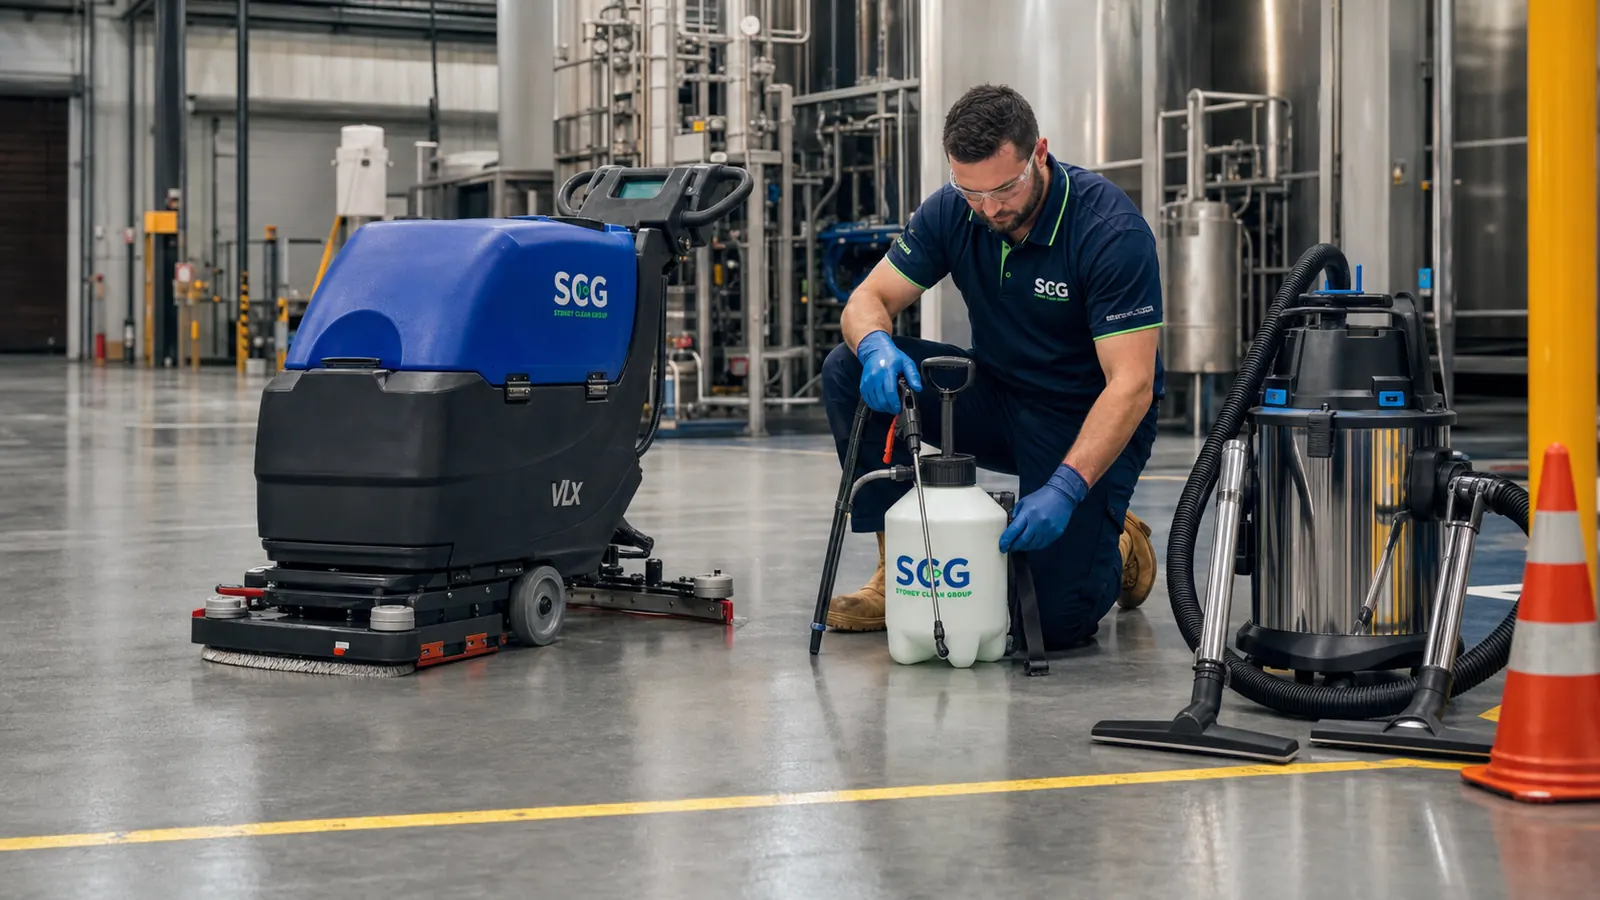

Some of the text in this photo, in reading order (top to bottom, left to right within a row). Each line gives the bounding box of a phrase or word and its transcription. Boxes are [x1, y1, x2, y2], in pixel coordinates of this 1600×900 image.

[554, 271, 608, 308] SCG
[1034, 277, 1069, 298] SCG
[551, 479, 584, 507] VLX
[896, 555, 970, 589] SCG
